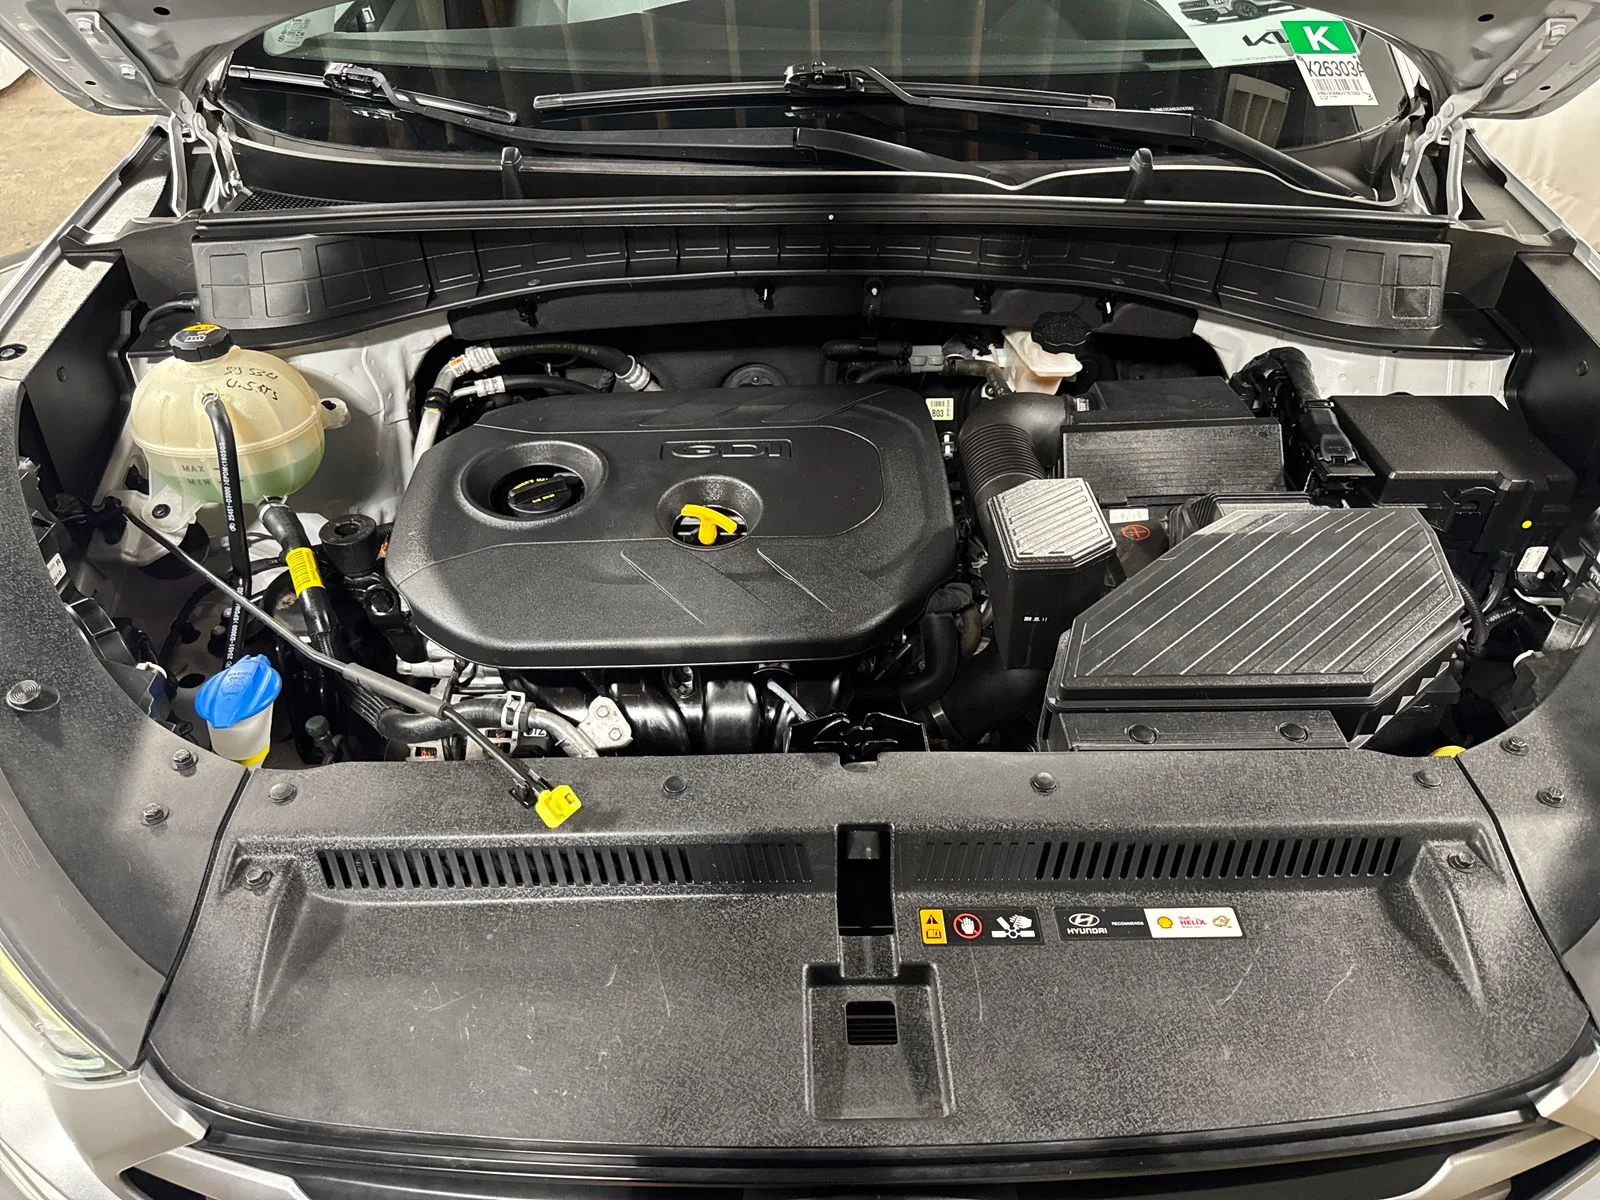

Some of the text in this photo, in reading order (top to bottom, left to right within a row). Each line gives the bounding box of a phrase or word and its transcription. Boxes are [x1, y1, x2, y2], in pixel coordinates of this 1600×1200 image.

[1303, 26, 1340, 51] K
[671, 443, 782, 459] GDI
[181, 464, 205, 473] MAX
[1067, 927, 1108, 935] HYUNDAI
